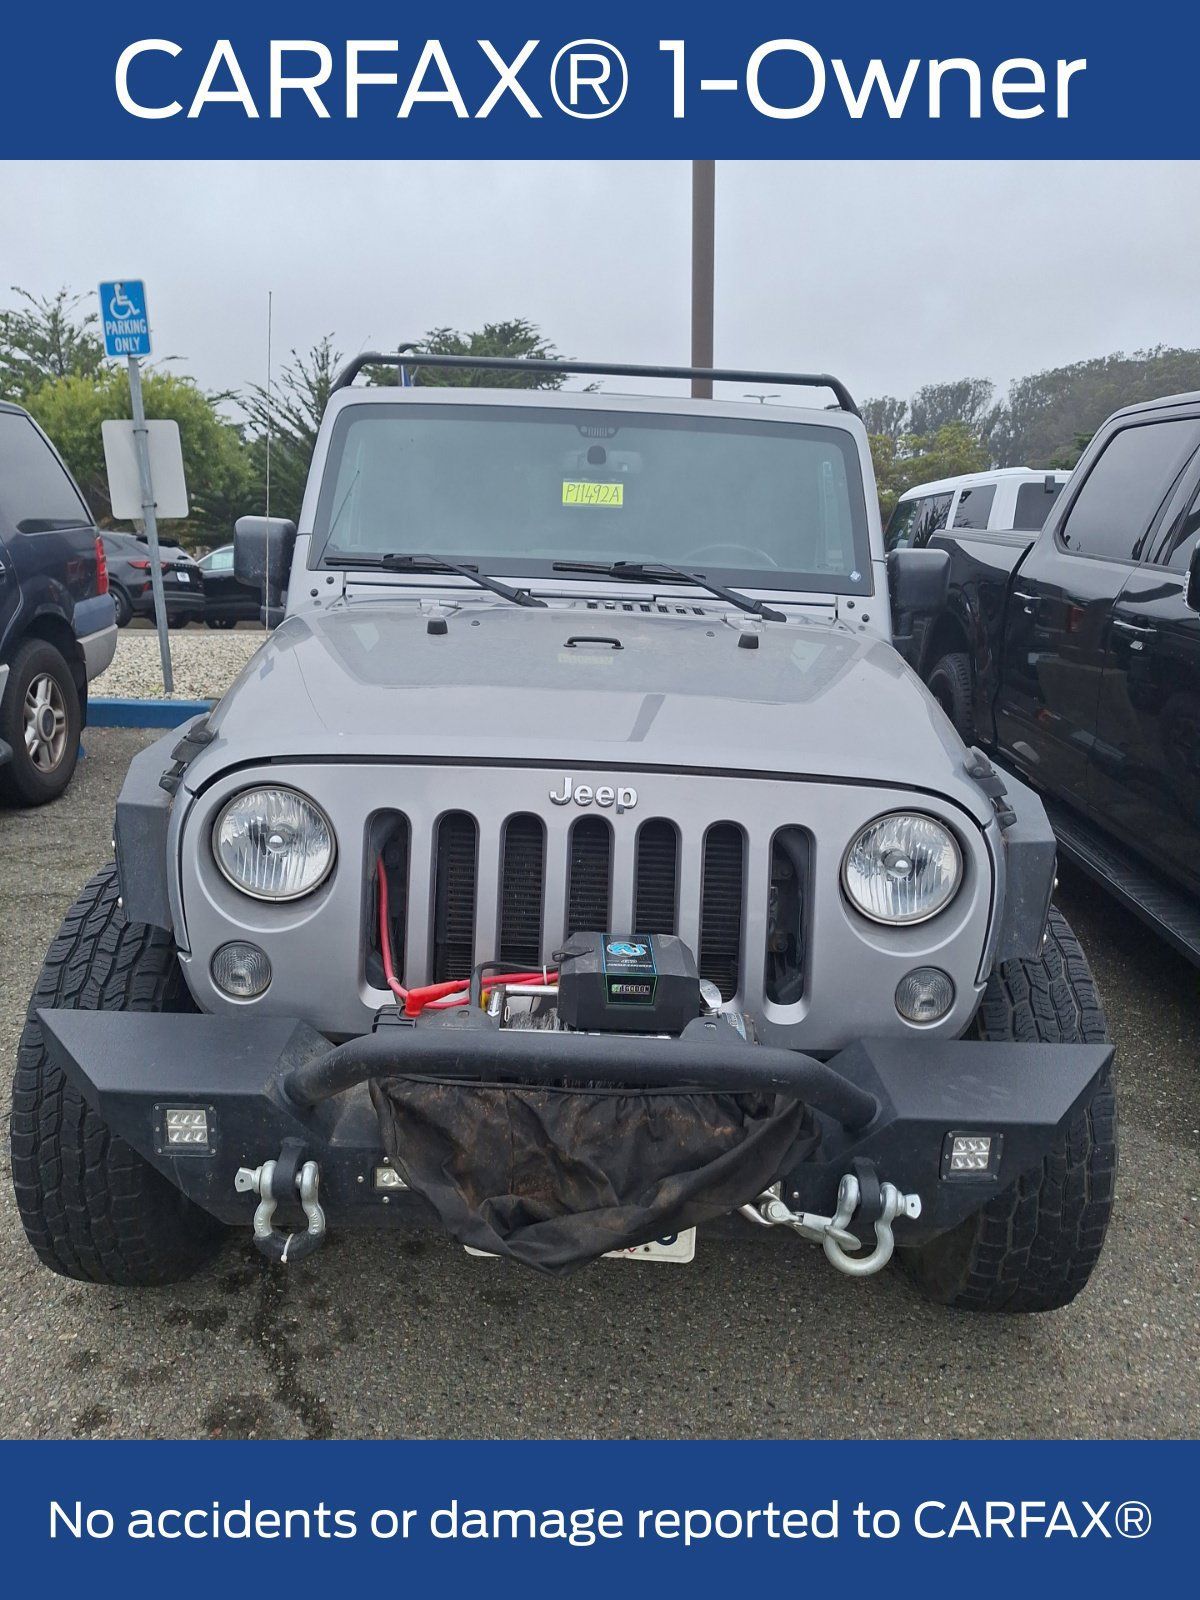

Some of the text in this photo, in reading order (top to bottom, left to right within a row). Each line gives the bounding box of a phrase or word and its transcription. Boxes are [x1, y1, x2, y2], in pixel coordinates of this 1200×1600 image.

[105, 319, 147, 335] PARKING
[114, 337, 141, 352] ONLY
[565, 483, 620, 503] P11492A
[549, 776, 638, 815] Jeep
